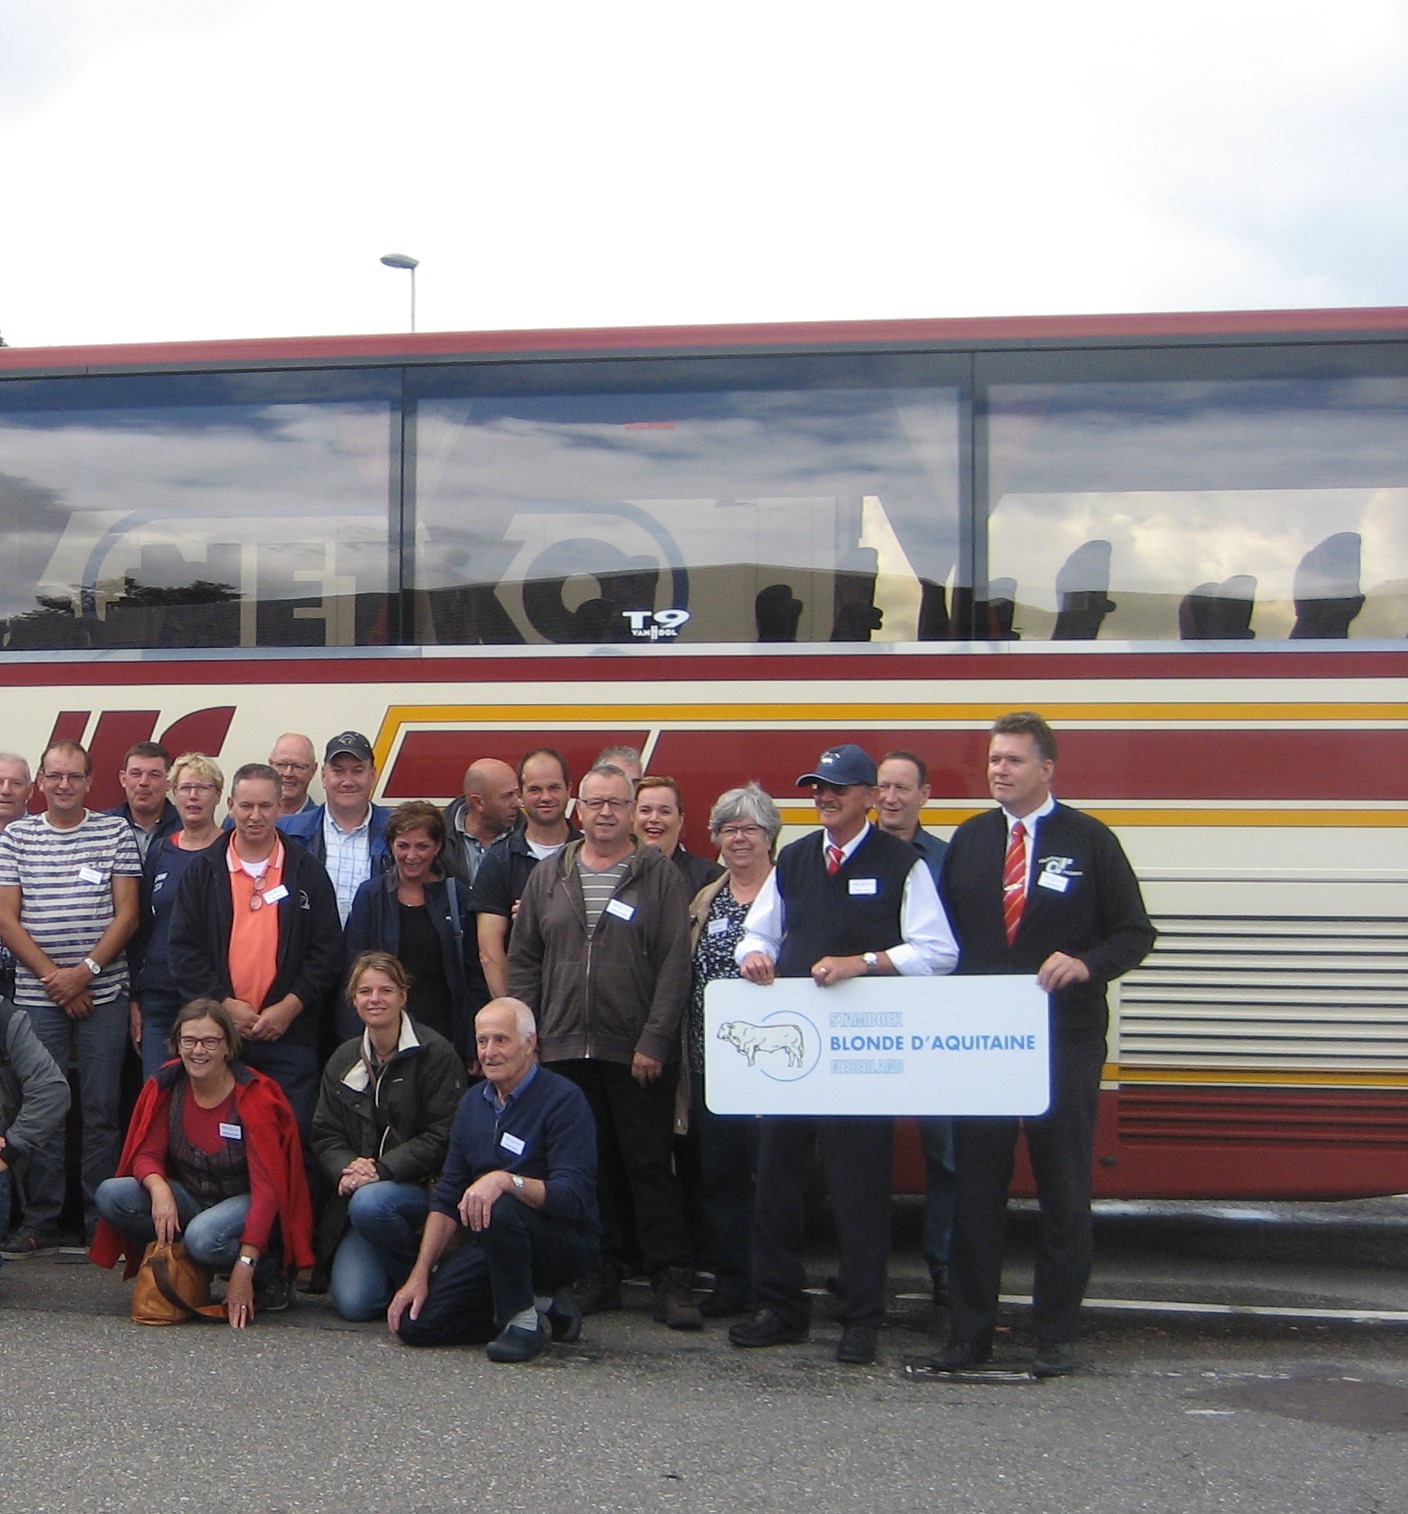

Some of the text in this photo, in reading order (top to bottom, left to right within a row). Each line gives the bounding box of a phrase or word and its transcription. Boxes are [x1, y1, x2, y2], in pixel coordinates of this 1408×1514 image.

[621, 609, 690, 629] T9
[829, 1011, 904, 1028] STAMBOEK
[830, 1034, 1036, 1051] BLONDE D'AQUITAINE
[830, 1058, 905, 1075] NEDERLAND
